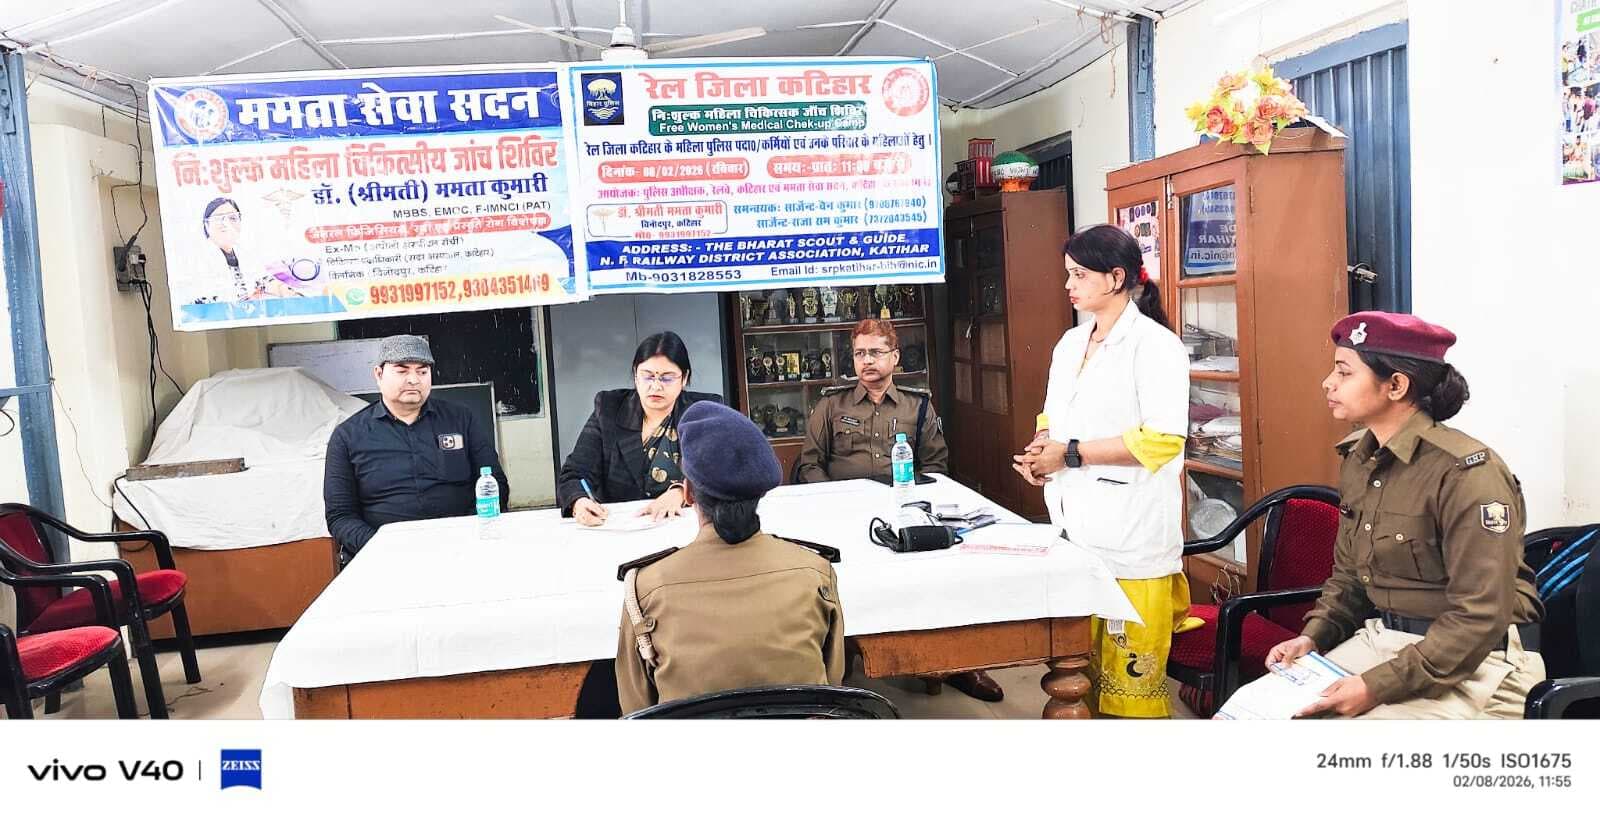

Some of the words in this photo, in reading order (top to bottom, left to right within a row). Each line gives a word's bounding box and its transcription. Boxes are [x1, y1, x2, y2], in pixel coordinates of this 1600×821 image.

[638, 71, 688, 99] रेल
[695, 71, 769, 98] जिला
[776, 69, 873, 97] कटिहार
[235, 94, 348, 131] ममता
[356, 82, 438, 126] सेवा
[447, 87, 541, 122] सदन
[704, 108, 741, 120] महिला
[659, 123, 685, 132] Free
[687, 121, 738, 132] Women's
[741, 119, 783, 131] Medical
[786, 118, 832, 130] Chek-up
[584, 141, 600, 156] रेल
[603, 141, 627, 155] जिला
[630, 140, 662, 155] कटिहार
[664, 139, 673, 154] के
[676, 138, 704, 153] महिला
[707, 137, 732, 156] पुलिस
[793, 134, 806, 150] एवं
[831, 133, 859, 149] परिार
[861, 133, 870, 148] के
[912, 132, 925, 150] हेतु
[266, 145, 340, 181] महिला
[345, 141, 447, 177] चिकित्सीय
[450, 139, 493, 171] जांच
[496, 134, 558, 169] शिविर
[311, 183, 341, 205] डॉ.
[347, 180, 429, 208] (श्रीमती)
[434, 180, 488, 198] ममता
[488, 172, 548, 200] कुमारी
[643, 185, 668, 200] पुलिस
[737, 182, 766, 195] कटिहार
[783, 182, 806, 192] ममता
[476, 202, 519, 214] F-IMNCI
[522, 200, 551, 213] (PAT)
[634, 204, 663, 217] श्रीमती
[667, 204, 692, 216] ममता
[694, 201, 723, 218] कुमारी
[676, 217, 702, 228] कटिहार
[815, 215, 831, 226] राम
[833, 213, 859, 228] कुमार
[622, 242, 692, 255] ADDRESS:
[705, 241, 734, 251] THE
[737, 239, 793, 251] BHARAT
[797, 236, 845, 248] SCOUT
[849, 236, 859, 245] &
[600, 256, 615, 266] N.
[632, 254, 696, 266] RAILWAY
[699, 251, 767, 263] DISTRICT
[768, 246, 865, 261] ASSOCIATION,
[869, 243, 930, 257] KATIHAR
[625, 269, 742, 282] Mb-9031828553
[770, 265, 801, 276] Email
